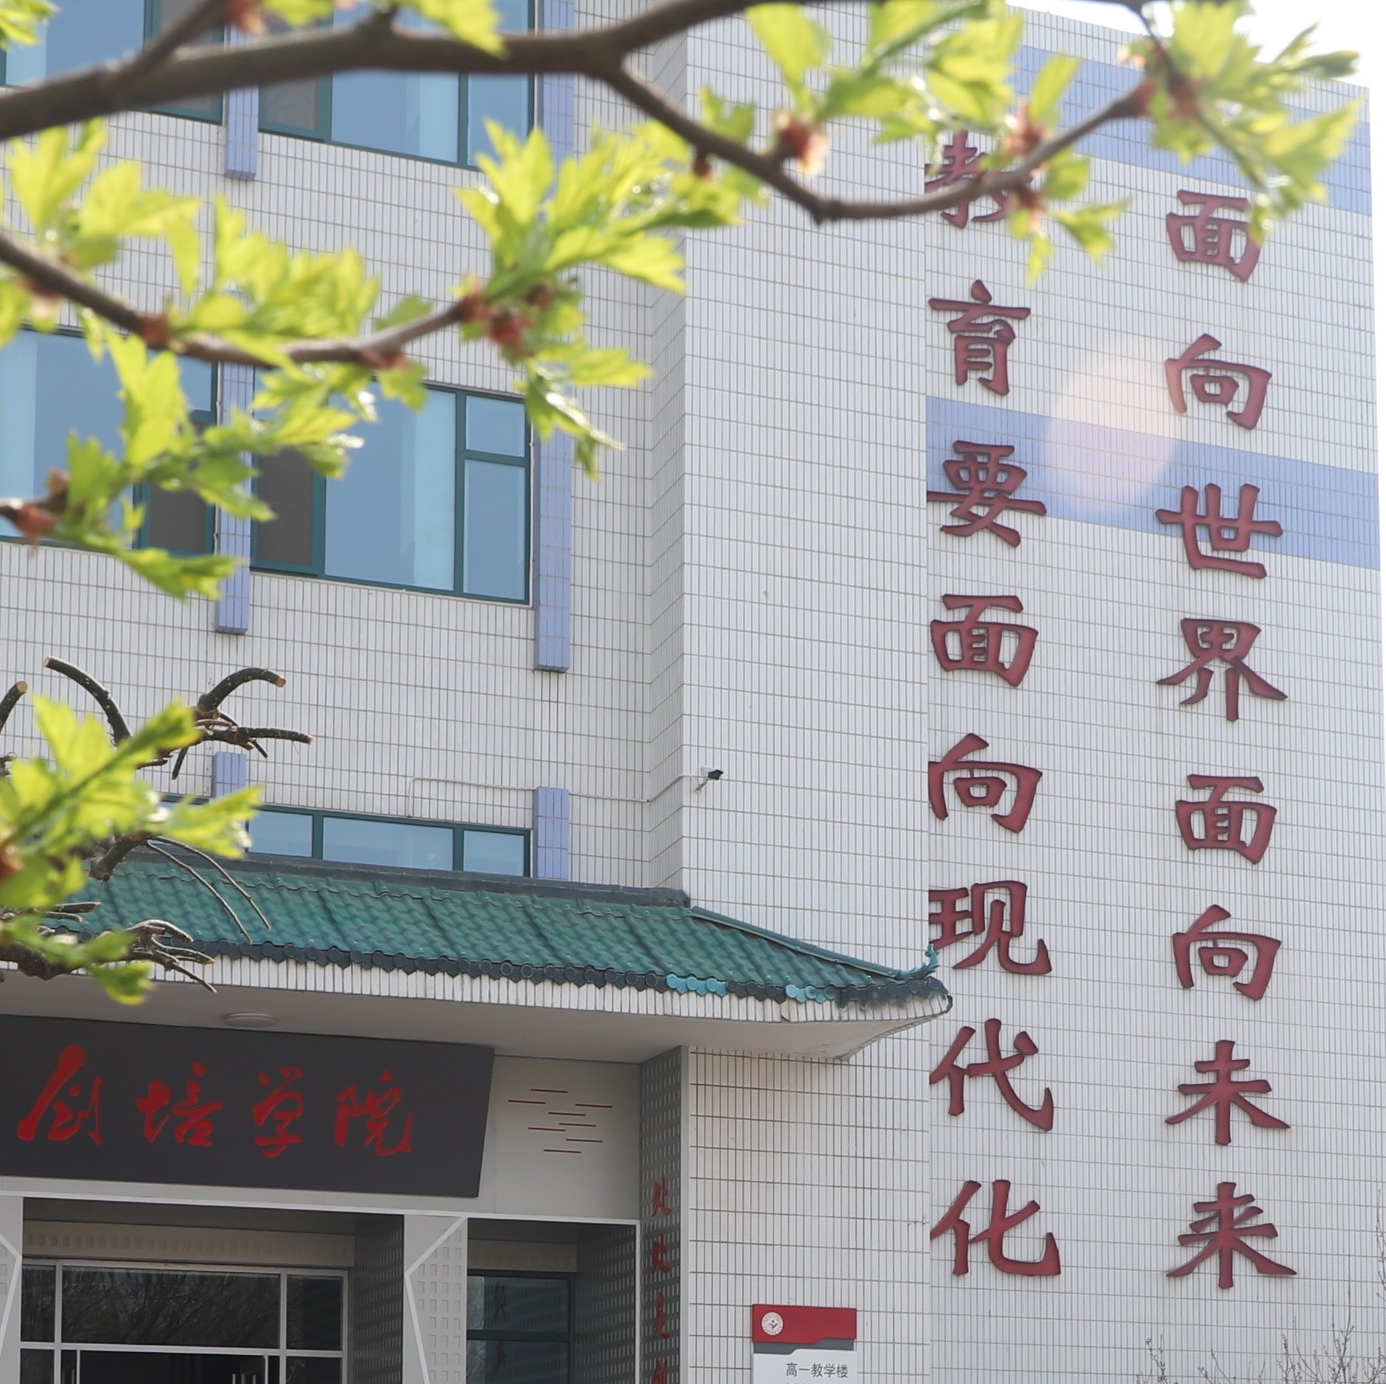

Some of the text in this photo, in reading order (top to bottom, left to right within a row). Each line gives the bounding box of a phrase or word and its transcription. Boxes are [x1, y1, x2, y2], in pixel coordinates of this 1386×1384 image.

[925, 131, 1062, 1277] 教育要面向现代化
[1156, 189, 1298, 1290] 面向世界面向未来
[17, 1043, 413, 1158] 创培学院
[785, 1362, 848, 1379] 高一教学楼
